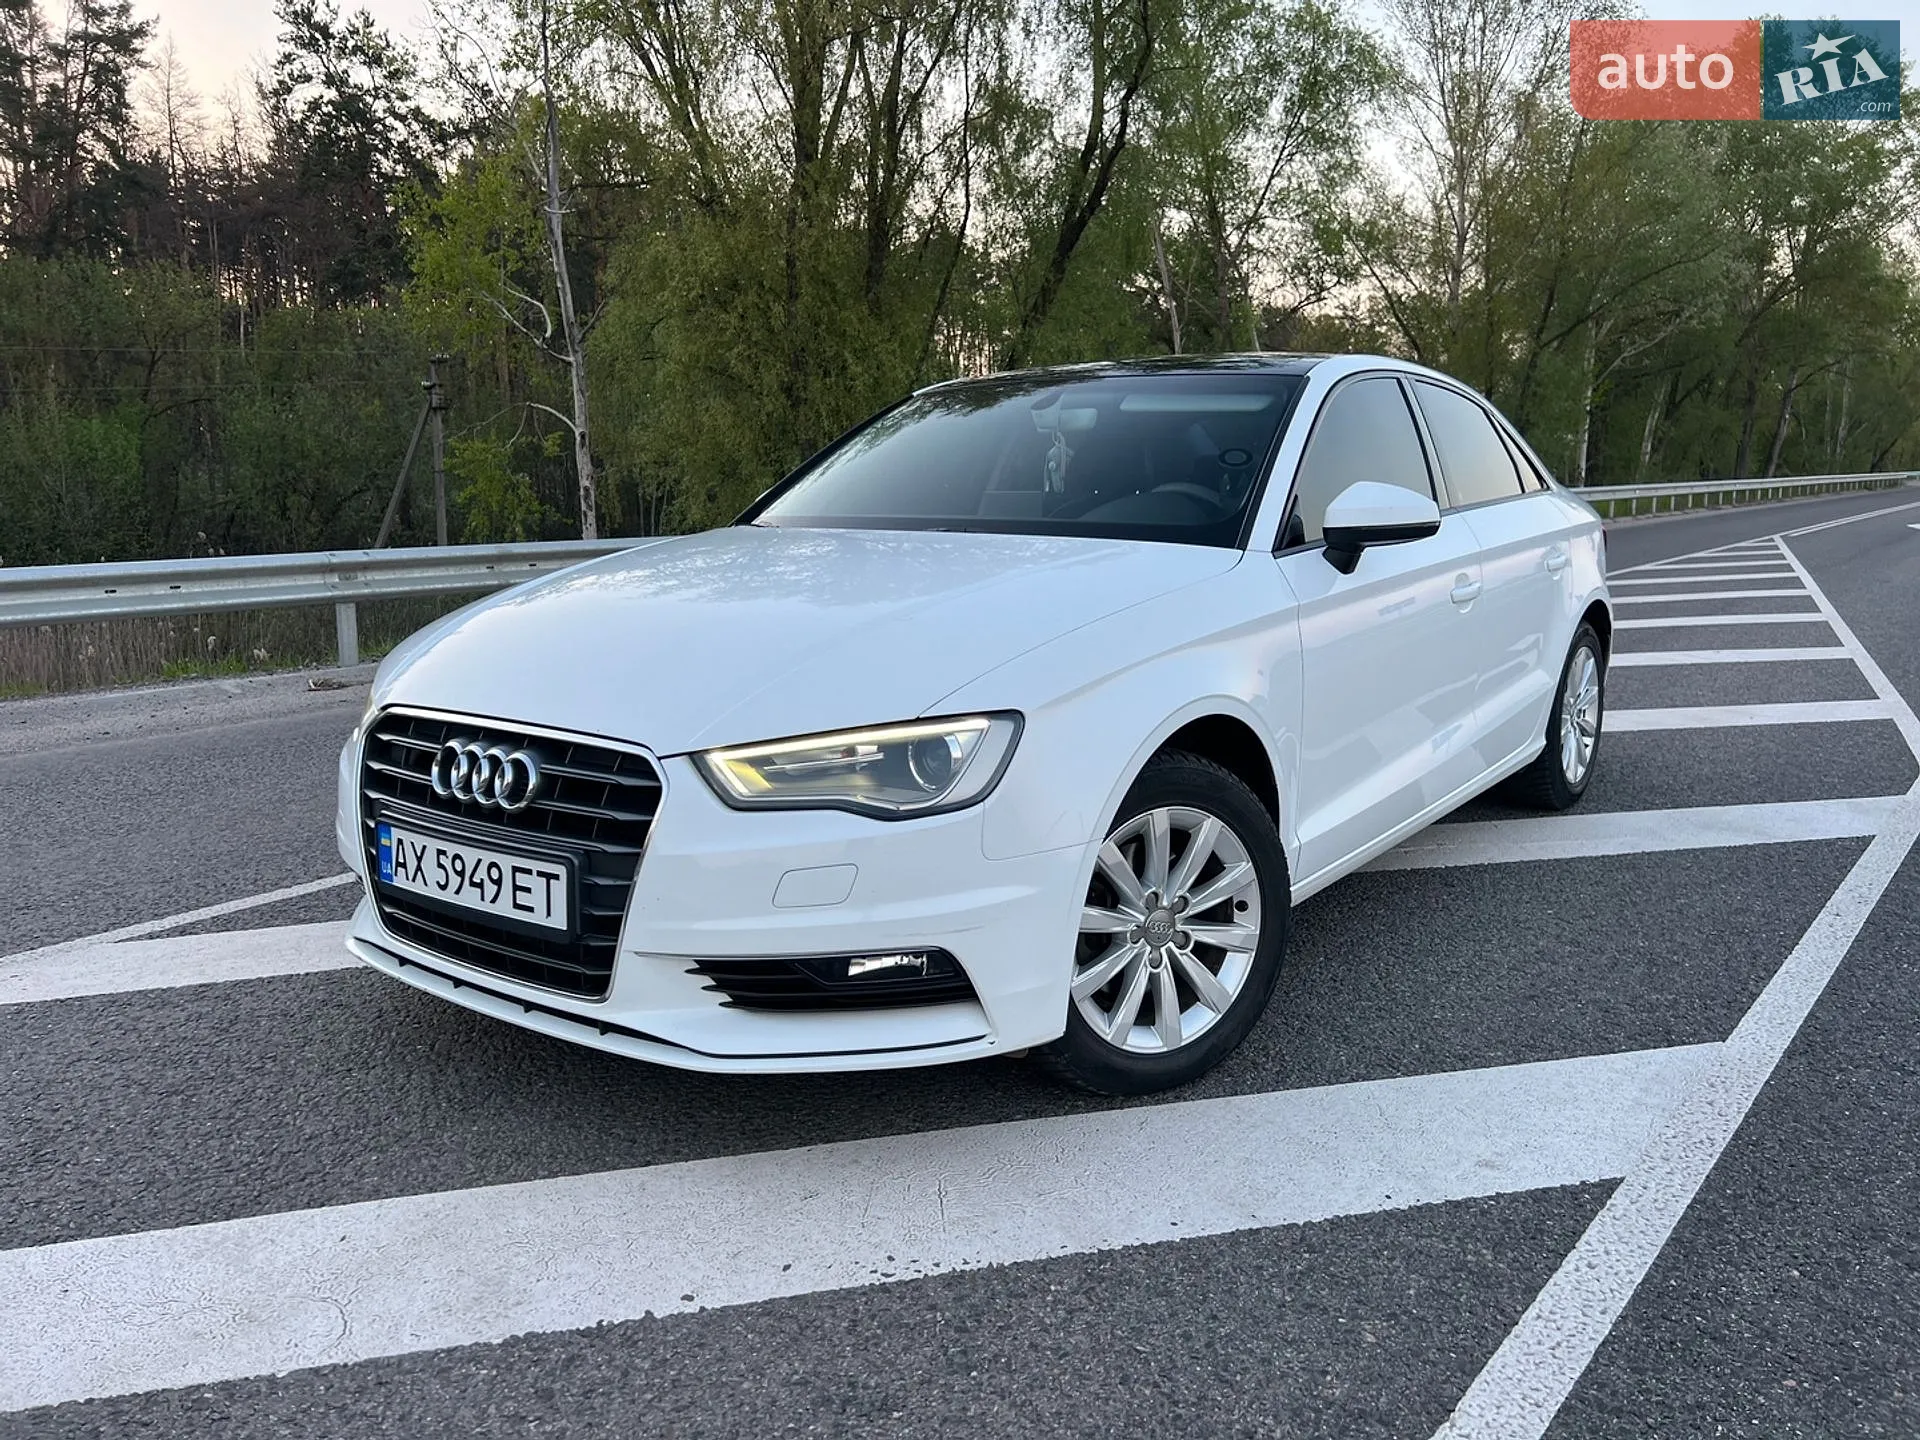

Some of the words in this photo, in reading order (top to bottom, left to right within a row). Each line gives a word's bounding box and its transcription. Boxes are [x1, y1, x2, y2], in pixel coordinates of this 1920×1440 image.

[381, 862, 392, 874] UA
[394, 838, 428, 887] AX
[435, 848, 503, 904] 5949
[511, 865, 560, 920] ET
